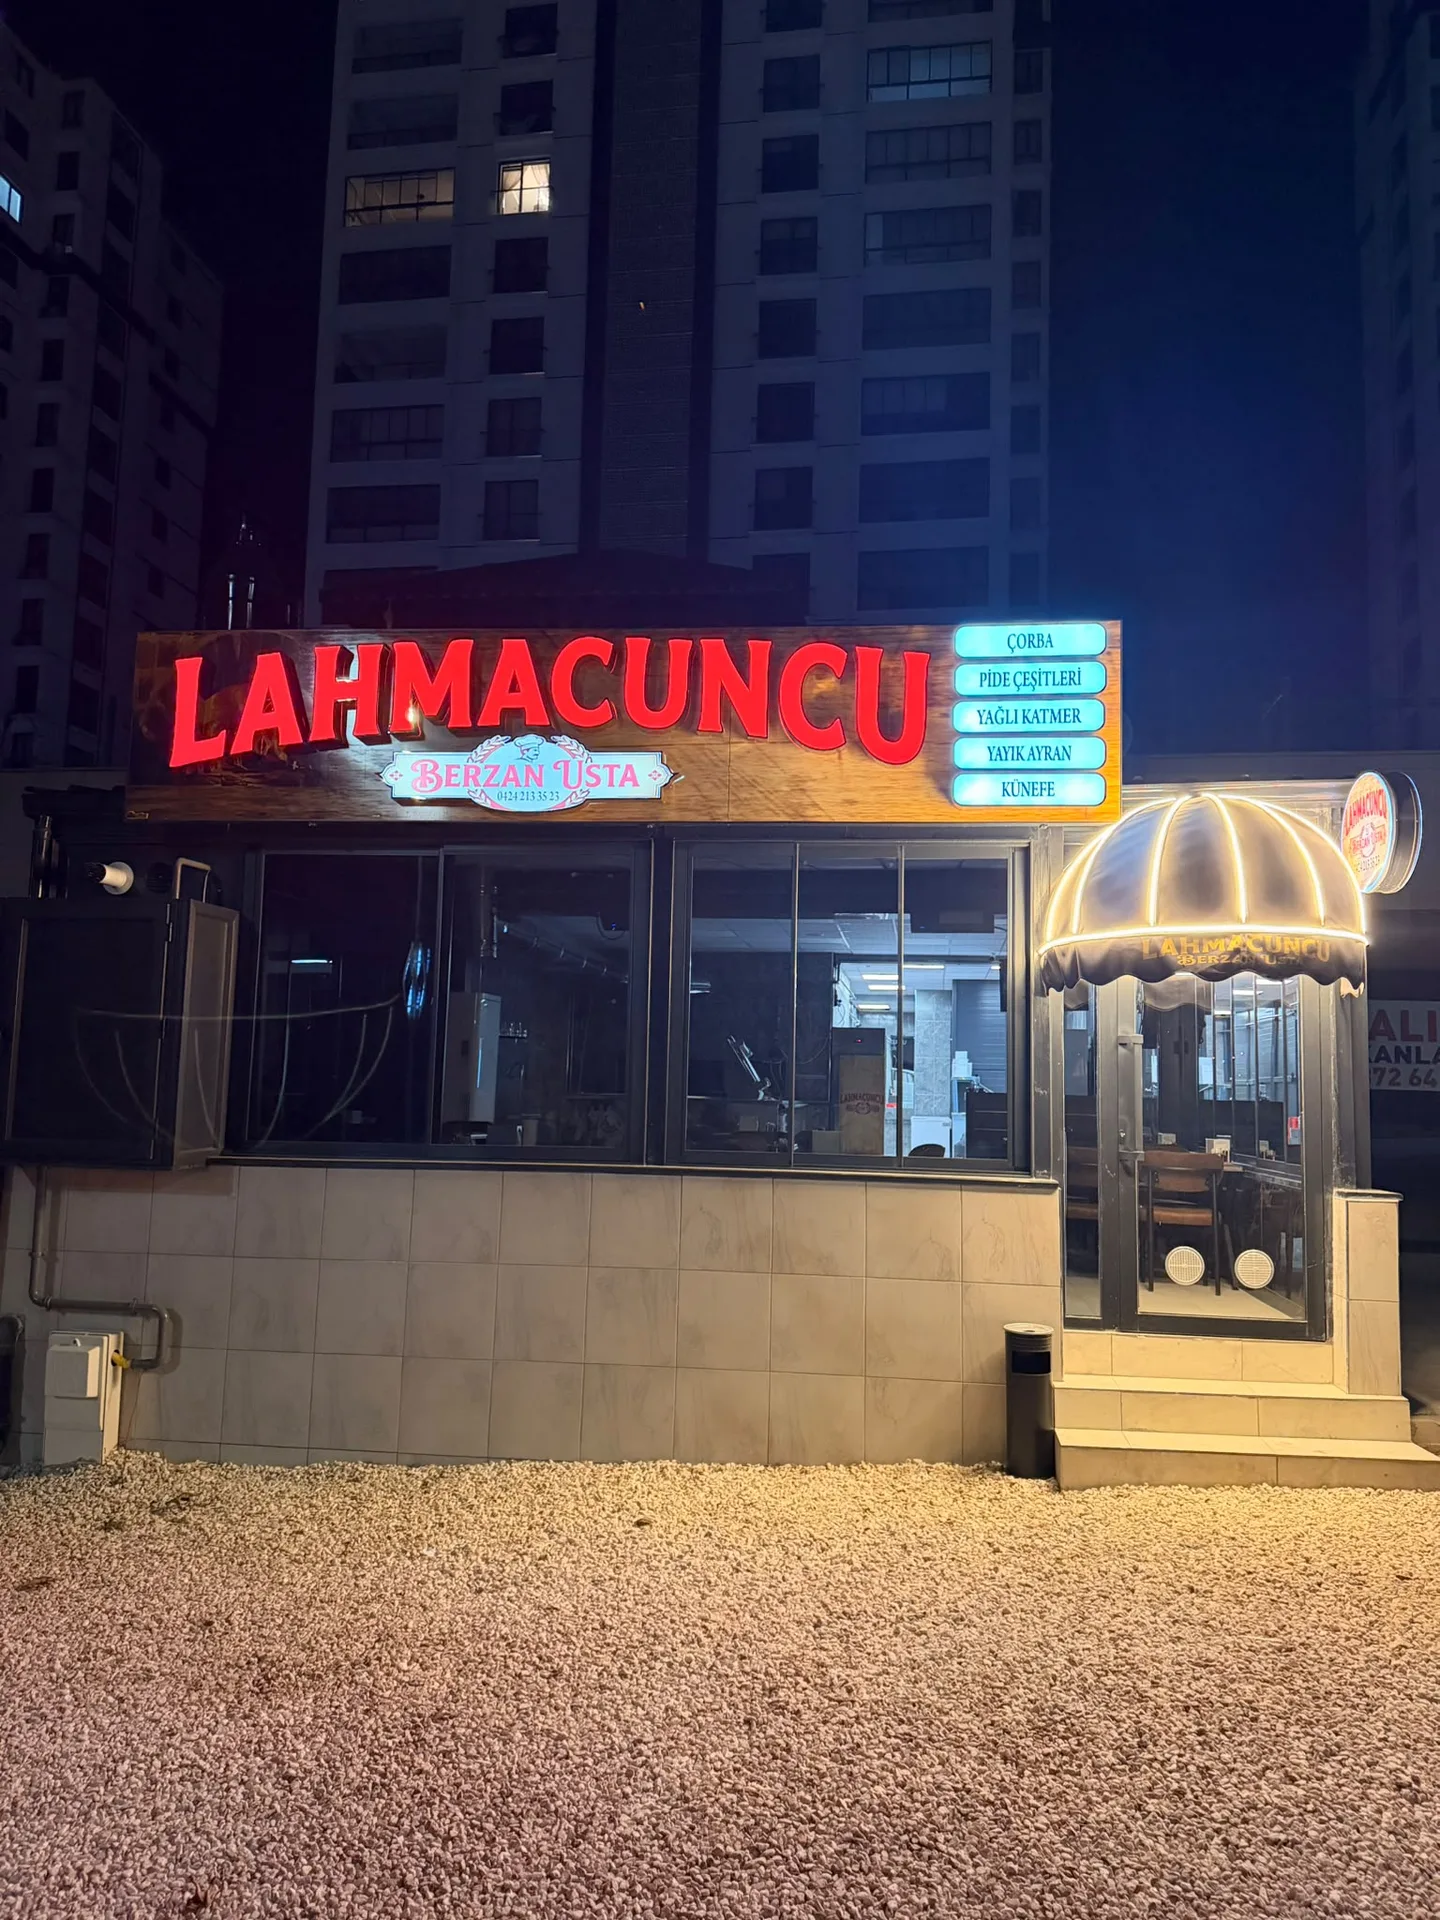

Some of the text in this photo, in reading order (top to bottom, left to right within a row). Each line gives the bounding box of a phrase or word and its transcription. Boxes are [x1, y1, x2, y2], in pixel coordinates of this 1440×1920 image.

[1007, 633, 1053, 653] ÇORBA
[979, 667, 1082, 691] PİDE ÇEŞİTLERİ
[169, 636, 930, 767] LAHMACUNCU
[977, 706, 1081, 725] YAĞLI KATMER
[987, 745, 1072, 762] YAYIK AYRAN
[410, 759, 640, 792] BERZAN USTA
[497, 791, 560, 801] 0424 213 35 23
[1001, 779, 1055, 797] KÜNEFE
[1140, 933, 1331, 962] LAHMACUNCU
